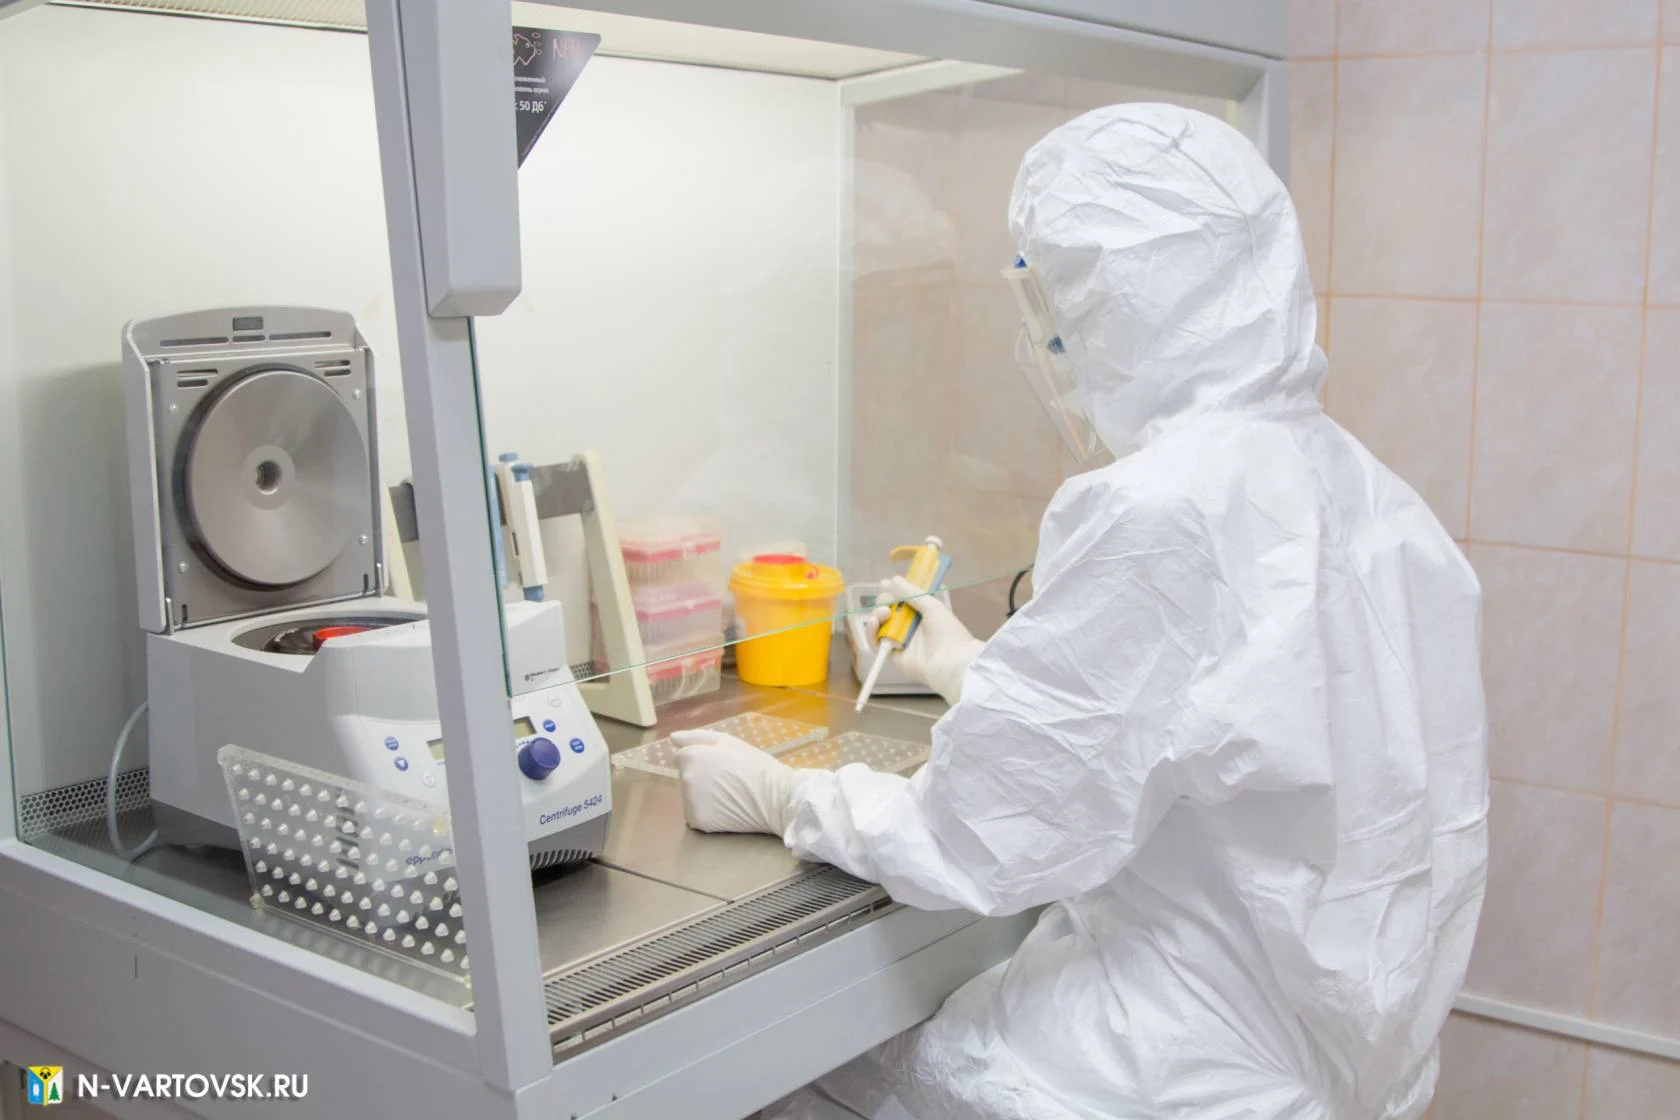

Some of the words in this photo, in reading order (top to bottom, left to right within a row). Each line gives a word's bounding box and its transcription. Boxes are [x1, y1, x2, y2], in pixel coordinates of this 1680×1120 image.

[519, 100, 531, 111] 50
[539, 804, 583, 825] Centrifuge
[583, 794, 603, 810] 5424
